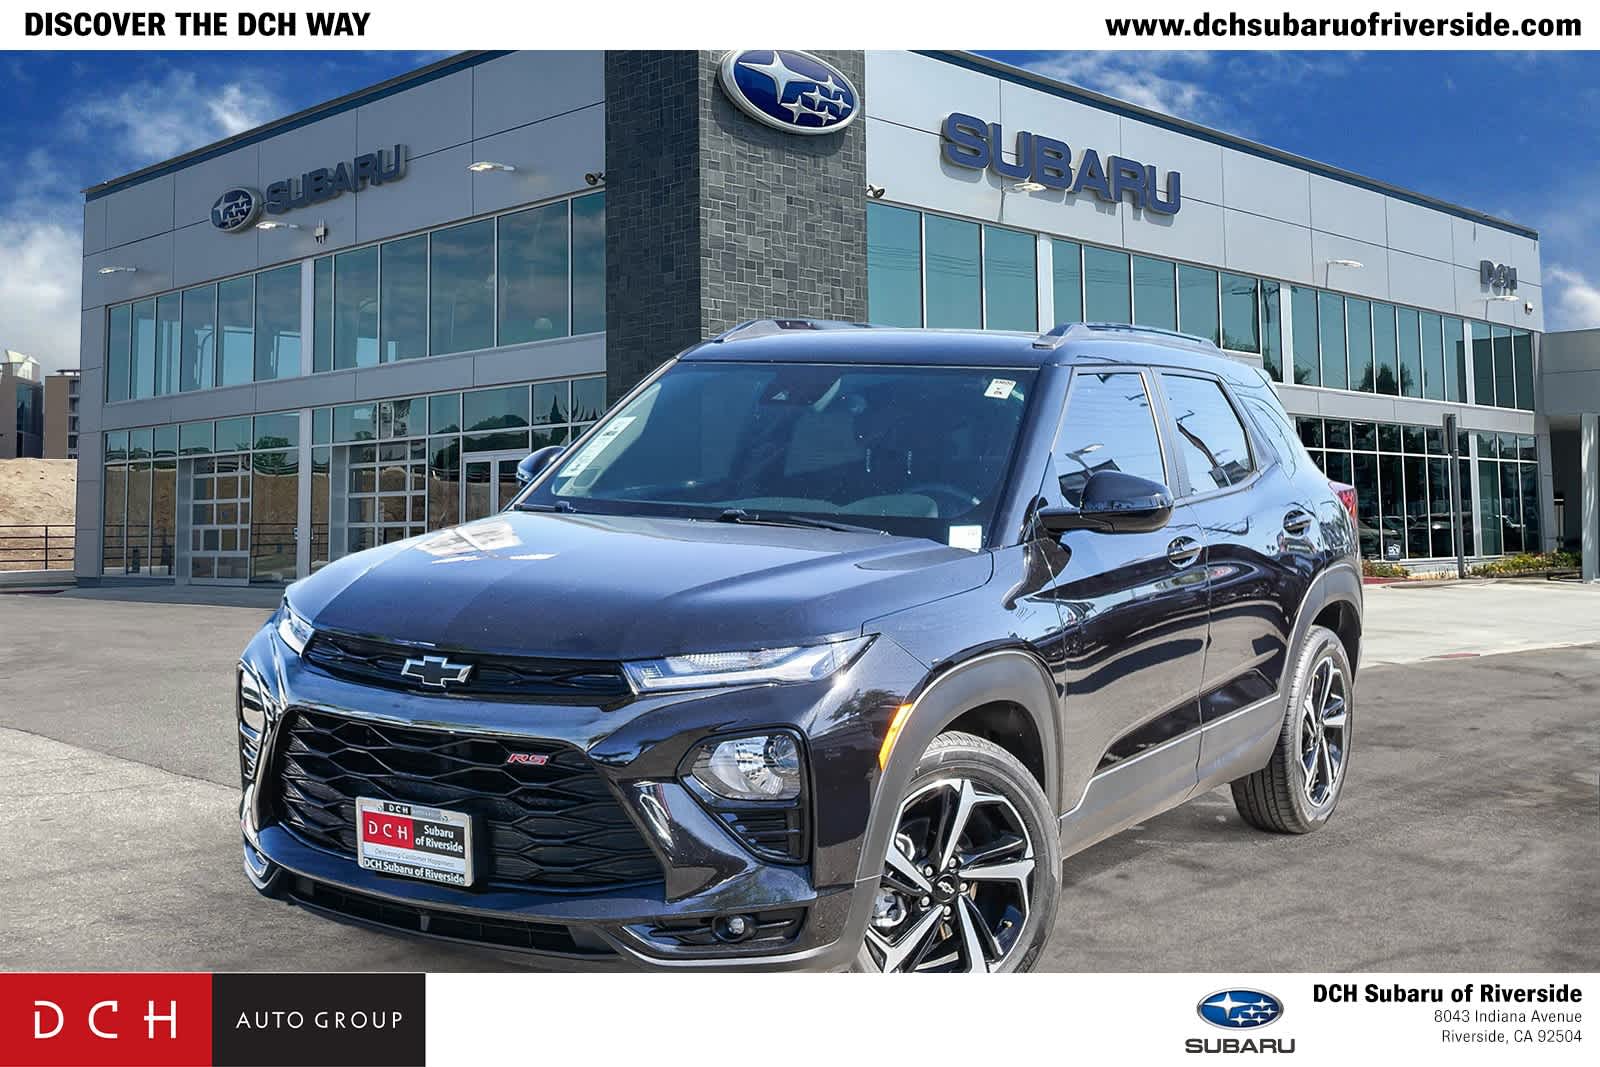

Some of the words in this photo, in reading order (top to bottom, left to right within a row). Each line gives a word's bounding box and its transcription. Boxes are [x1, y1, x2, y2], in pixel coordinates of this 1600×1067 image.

[942, 112, 1181, 215] SUBARU
[266, 144, 407, 215] SUBARU
[507, 753, 549, 766] RS
[423, 824, 454, 839] Subaru
[415, 836, 425, 846] of
[425, 838, 464, 853] Riverside
[364, 857, 383, 869] DCH
[383, 861, 413, 875] Subaru
[414, 867, 425, 876] of
[425, 868, 465, 884] Riverside
